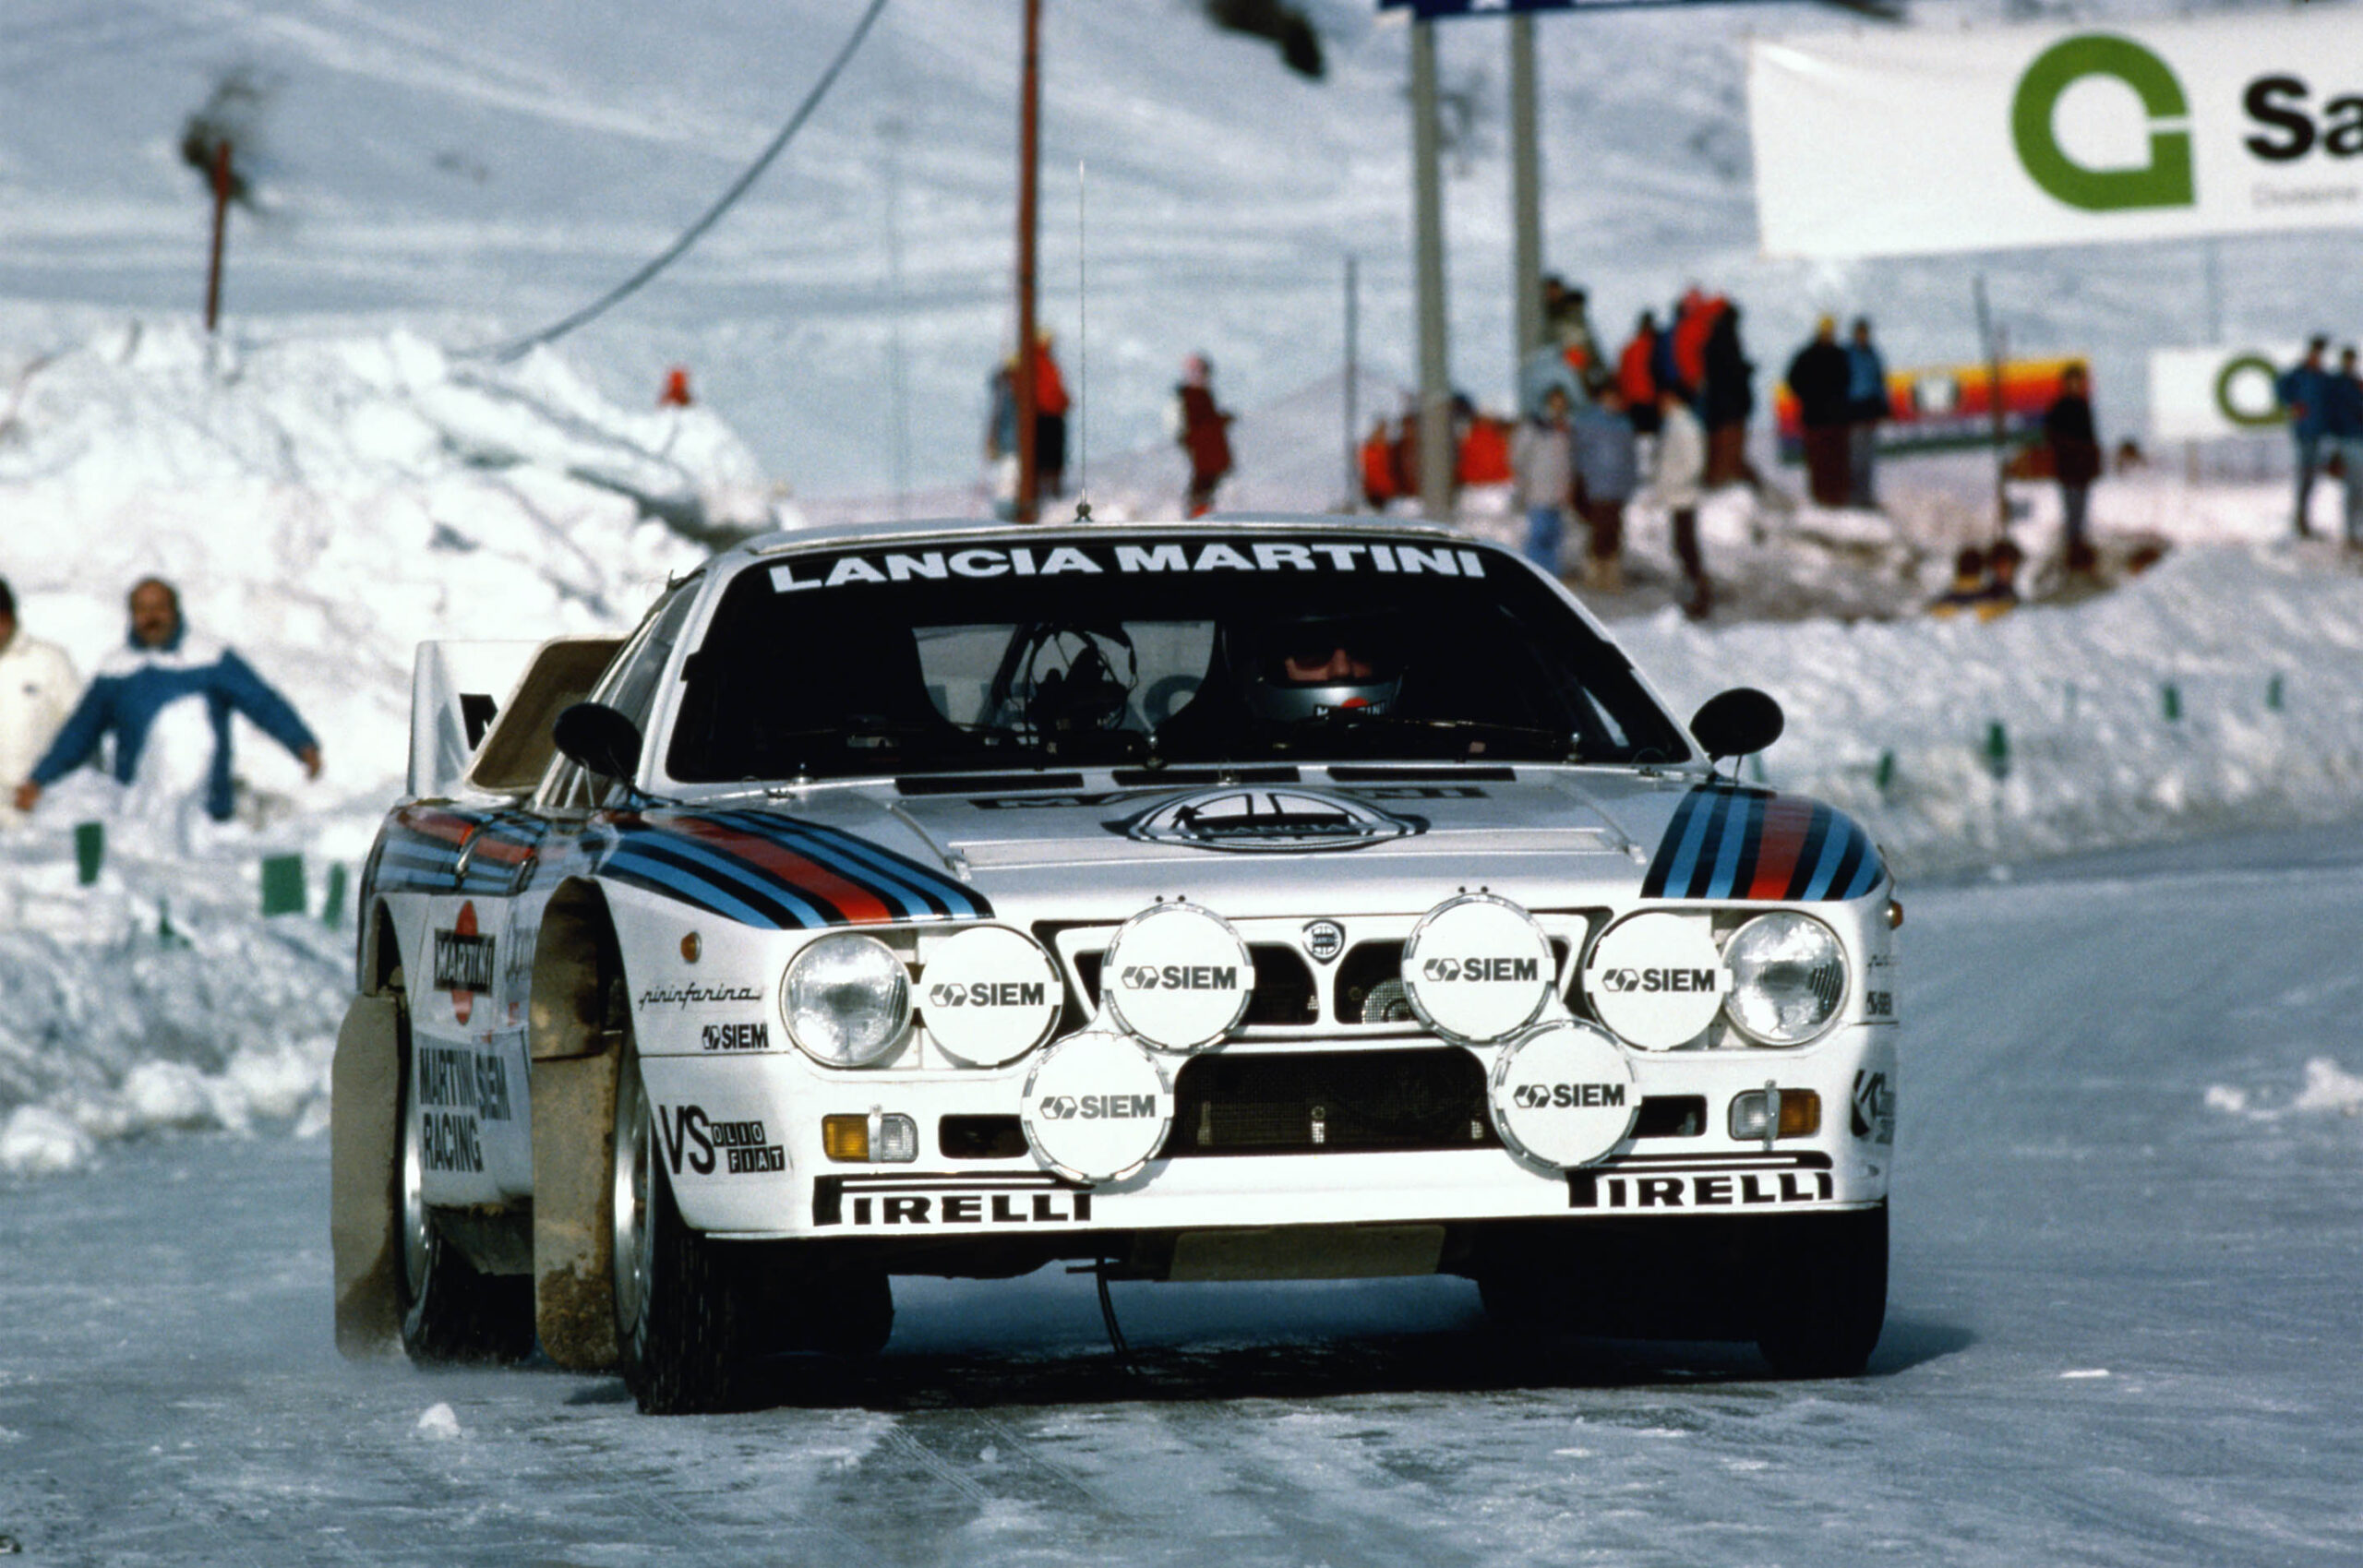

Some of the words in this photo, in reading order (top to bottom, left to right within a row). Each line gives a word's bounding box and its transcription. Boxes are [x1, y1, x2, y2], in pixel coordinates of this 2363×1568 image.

[770, 546, 1104, 593] LANCIA
[1113, 543, 1486, 579] MARTINI
[435, 939, 494, 987] MARTINI
[1463, 957, 1539, 982] SIEM
[1162, 965, 1237, 990] SIEM
[1642, 967, 1716, 992] SIEM
[638, 982, 765, 1011] pininfarina
[970, 982, 1045, 1007] SIEM
[721, 1023, 769, 1050] SIEM
[1081, 1095, 1157, 1119] SIEM
[1553, 1083, 1625, 1107] SIEM
[423, 1112, 485, 1173] RACING
[658, 1105, 716, 1175] VS
[711, 1123, 764, 1145] OLIO
[729, 1149, 783, 1171] FIAT
[1565, 1151, 1833, 1208] PIRELLI
[812, 1169, 1096, 1227] PIRELLI
